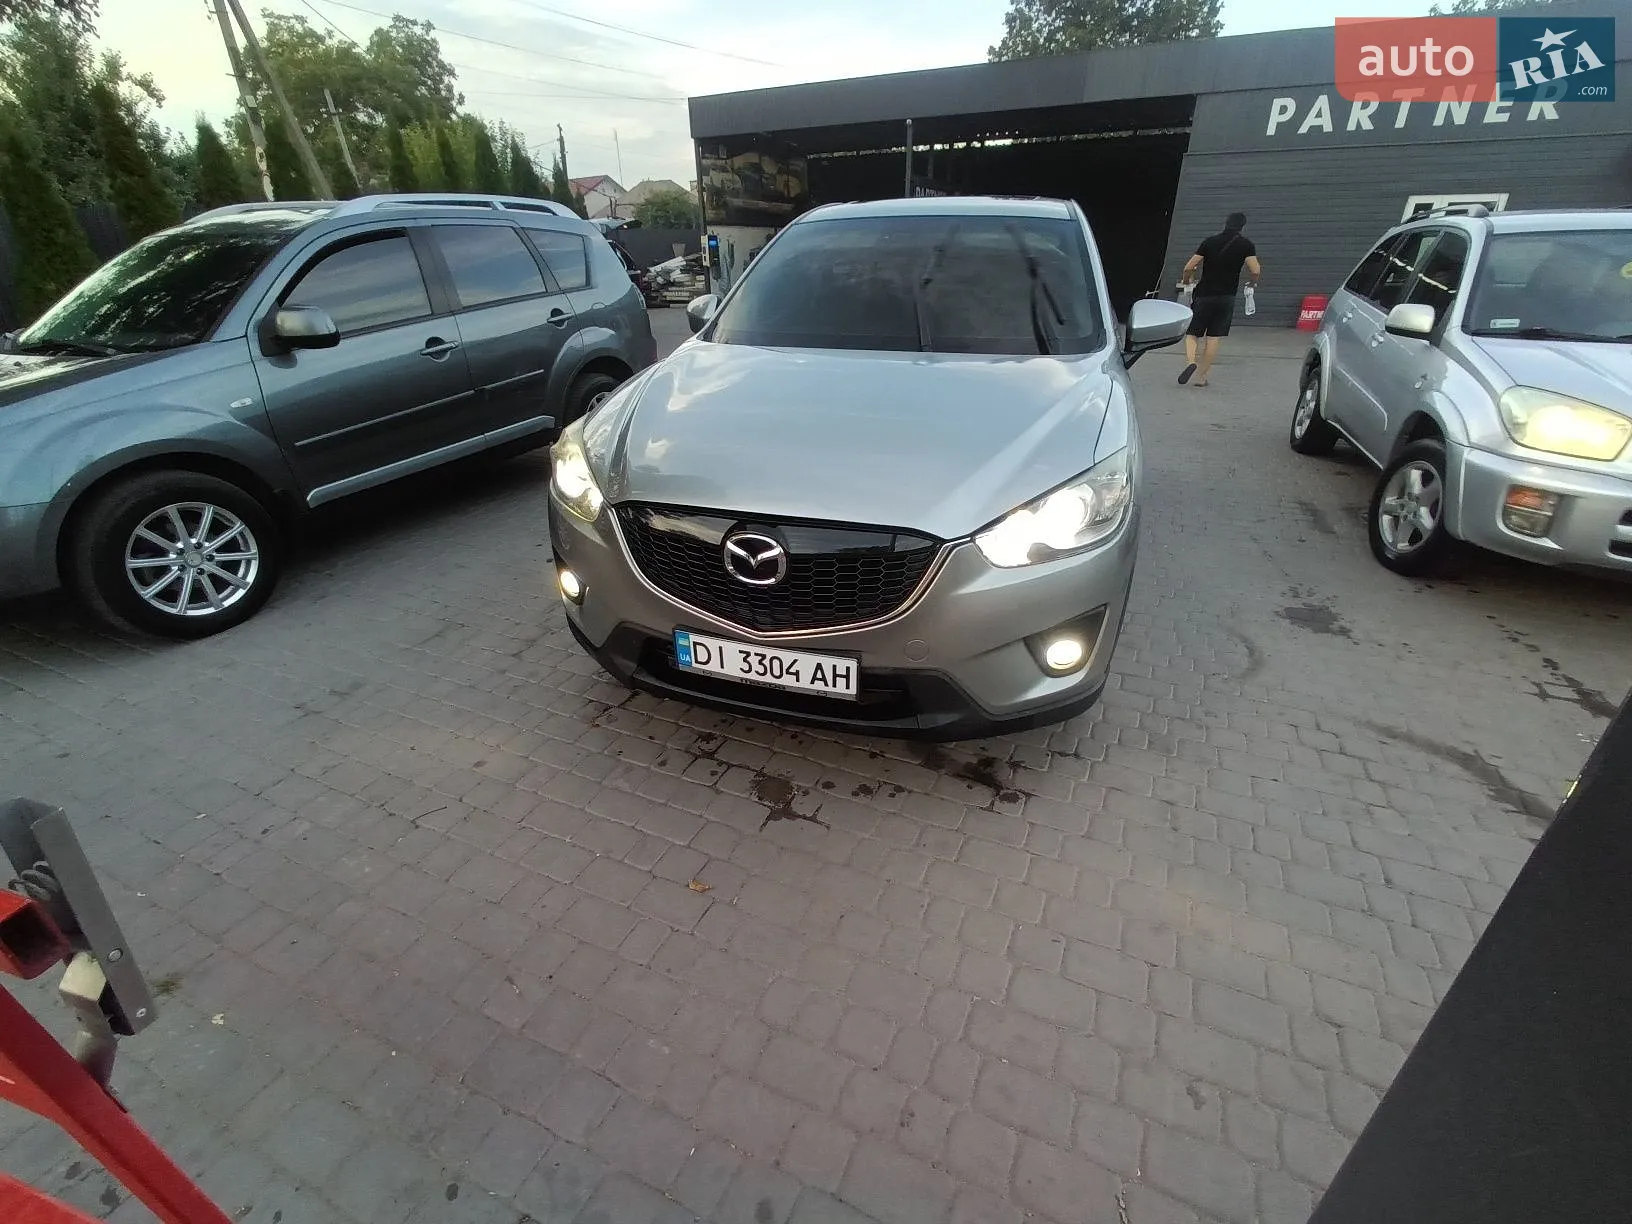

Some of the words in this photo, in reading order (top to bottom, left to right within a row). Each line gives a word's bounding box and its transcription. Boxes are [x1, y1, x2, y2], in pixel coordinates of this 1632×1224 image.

[1266, 78, 1569, 136] PARTNER
[680, 652, 691, 663] UA
[692, 641, 725, 670] DI
[738, 649, 801, 683] 3304
[809, 662, 851, 690] AH
